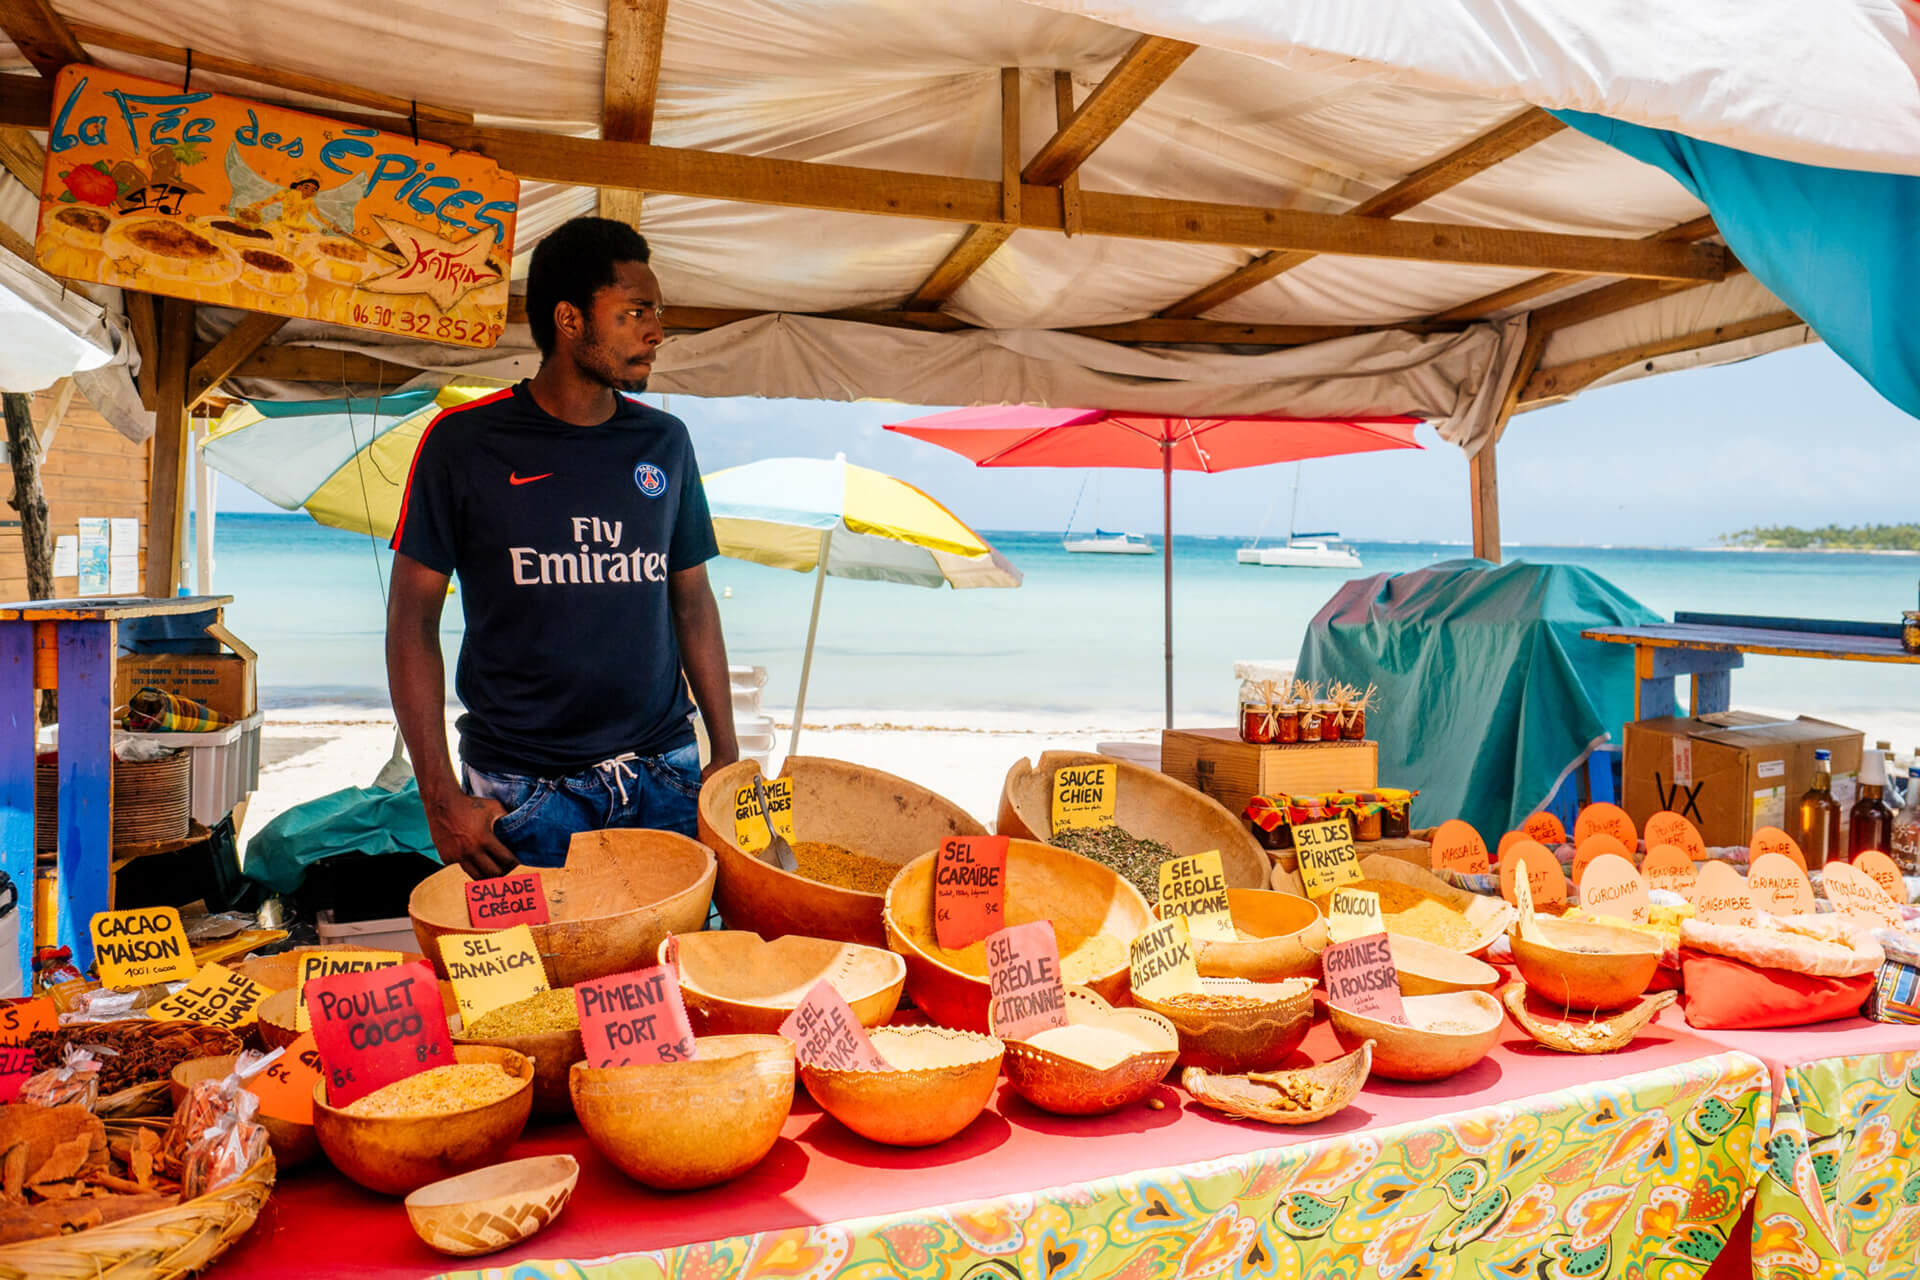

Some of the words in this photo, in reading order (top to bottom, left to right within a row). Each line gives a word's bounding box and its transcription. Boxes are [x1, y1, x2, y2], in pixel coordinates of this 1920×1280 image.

[52, 76, 108, 152] La
[103, 88, 216, 155] Fée
[235, 108, 304, 158] des
[570, 516, 623, 548] Fly
[508, 544, 667, 585] Emirates
[1059, 769, 1105, 787] SAUCE
[735, 797, 792, 820] GRILADES
[1298, 828, 1321, 847] SEL
[1321, 824, 1349, 843] DES
[944, 841, 975, 863] SEL
[938, 863, 1000, 887] CARAÏBE
[1171, 859, 1203, 880] SEL
[471, 878, 536, 902] SALADE
[1587, 880, 1639, 905] CURCUMA
[478, 895, 537, 918] CRÉOLE
[937, 908, 952, 922] 6€
[985, 902, 999, 915] 8€
[1164, 891, 1229, 919] BOUCANÉ
[1333, 892, 1376, 917] ROUCOU
[97, 914, 172, 938] CACAO
[463, 939, 501, 957] SEL
[990, 936, 1020, 967] SEL
[449, 951, 536, 979] JAMAÏCA
[992, 957, 1054, 996] CRÉOLE
[186, 973, 250, 1022] REOLE
[317, 977, 415, 1021] POULET
[1329, 975, 1340, 1000] À
[160, 986, 213, 1018] SEL
[349, 1014, 423, 1050] COCO
[605, 1014, 657, 1050] FORT
[796, 1002, 824, 1037] SEL
[800, 1006, 846, 1066] CRÉOLE
[415, 1042, 442, 1063] 8€
[656, 1036, 693, 1063] 8€
[333, 1067, 357, 1088] 6€
